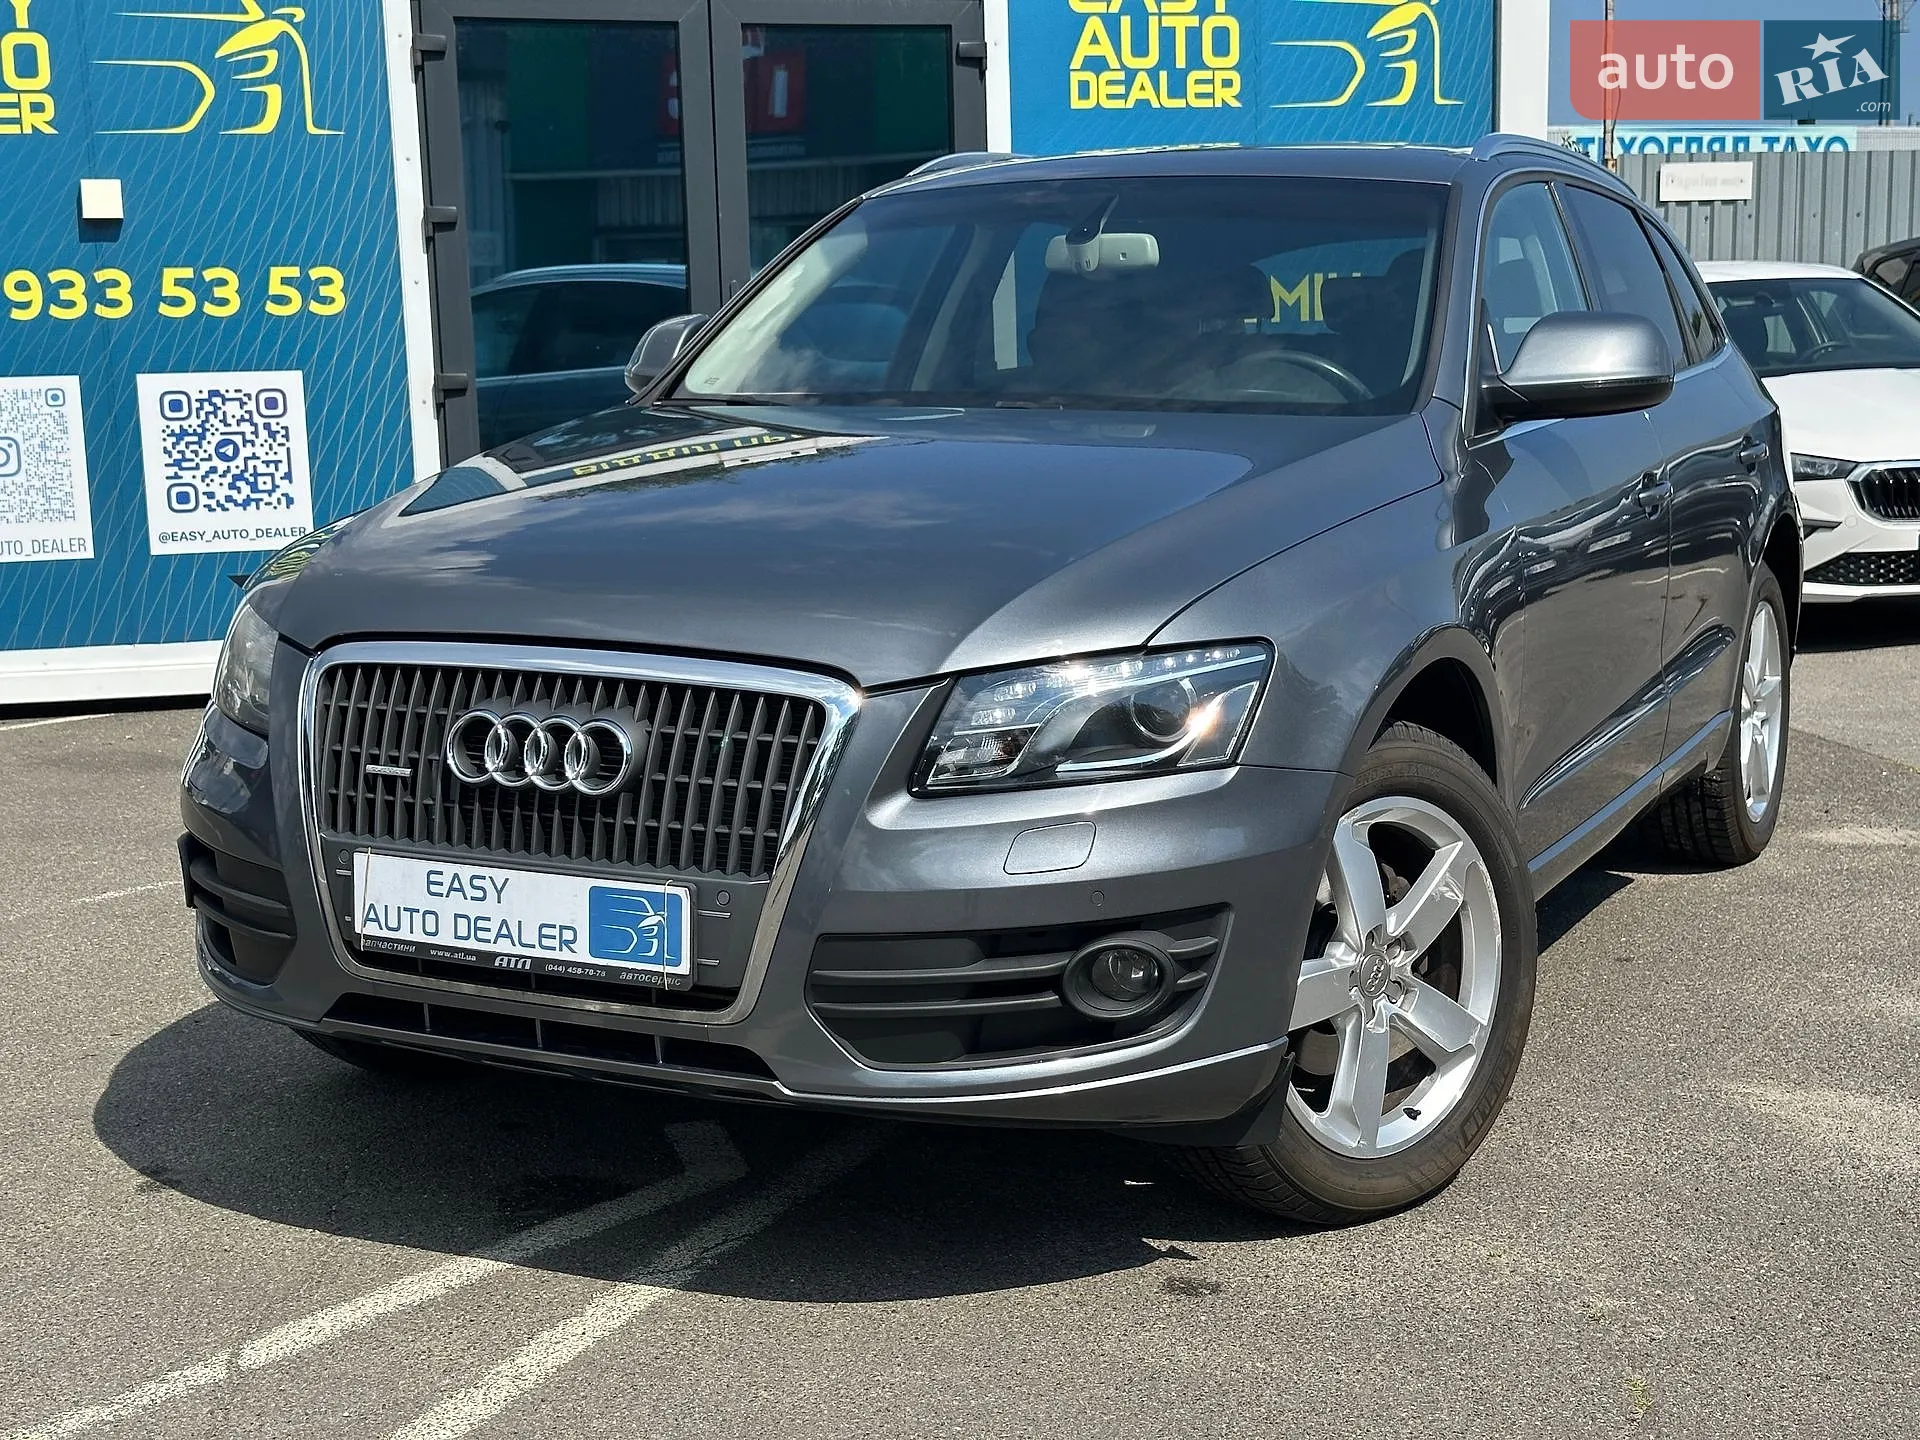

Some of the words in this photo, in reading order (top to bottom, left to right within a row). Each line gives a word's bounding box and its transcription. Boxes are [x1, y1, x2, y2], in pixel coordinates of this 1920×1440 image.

[1069, 15, 1240, 70] AUTO
[1070, 70, 1243, 109] DEALER
[3, 268, 135, 321] 933
[158, 266, 241, 319] 53
[264, 266, 346, 318] 53
[158, 526, 307, 543] @EASY_AUTO_DEALER
[426, 869, 509, 904] EASY
[363, 902, 440, 937] AUTO
[454, 912, 578, 953] DEALER
[545, 963, 566, 974] (044)
